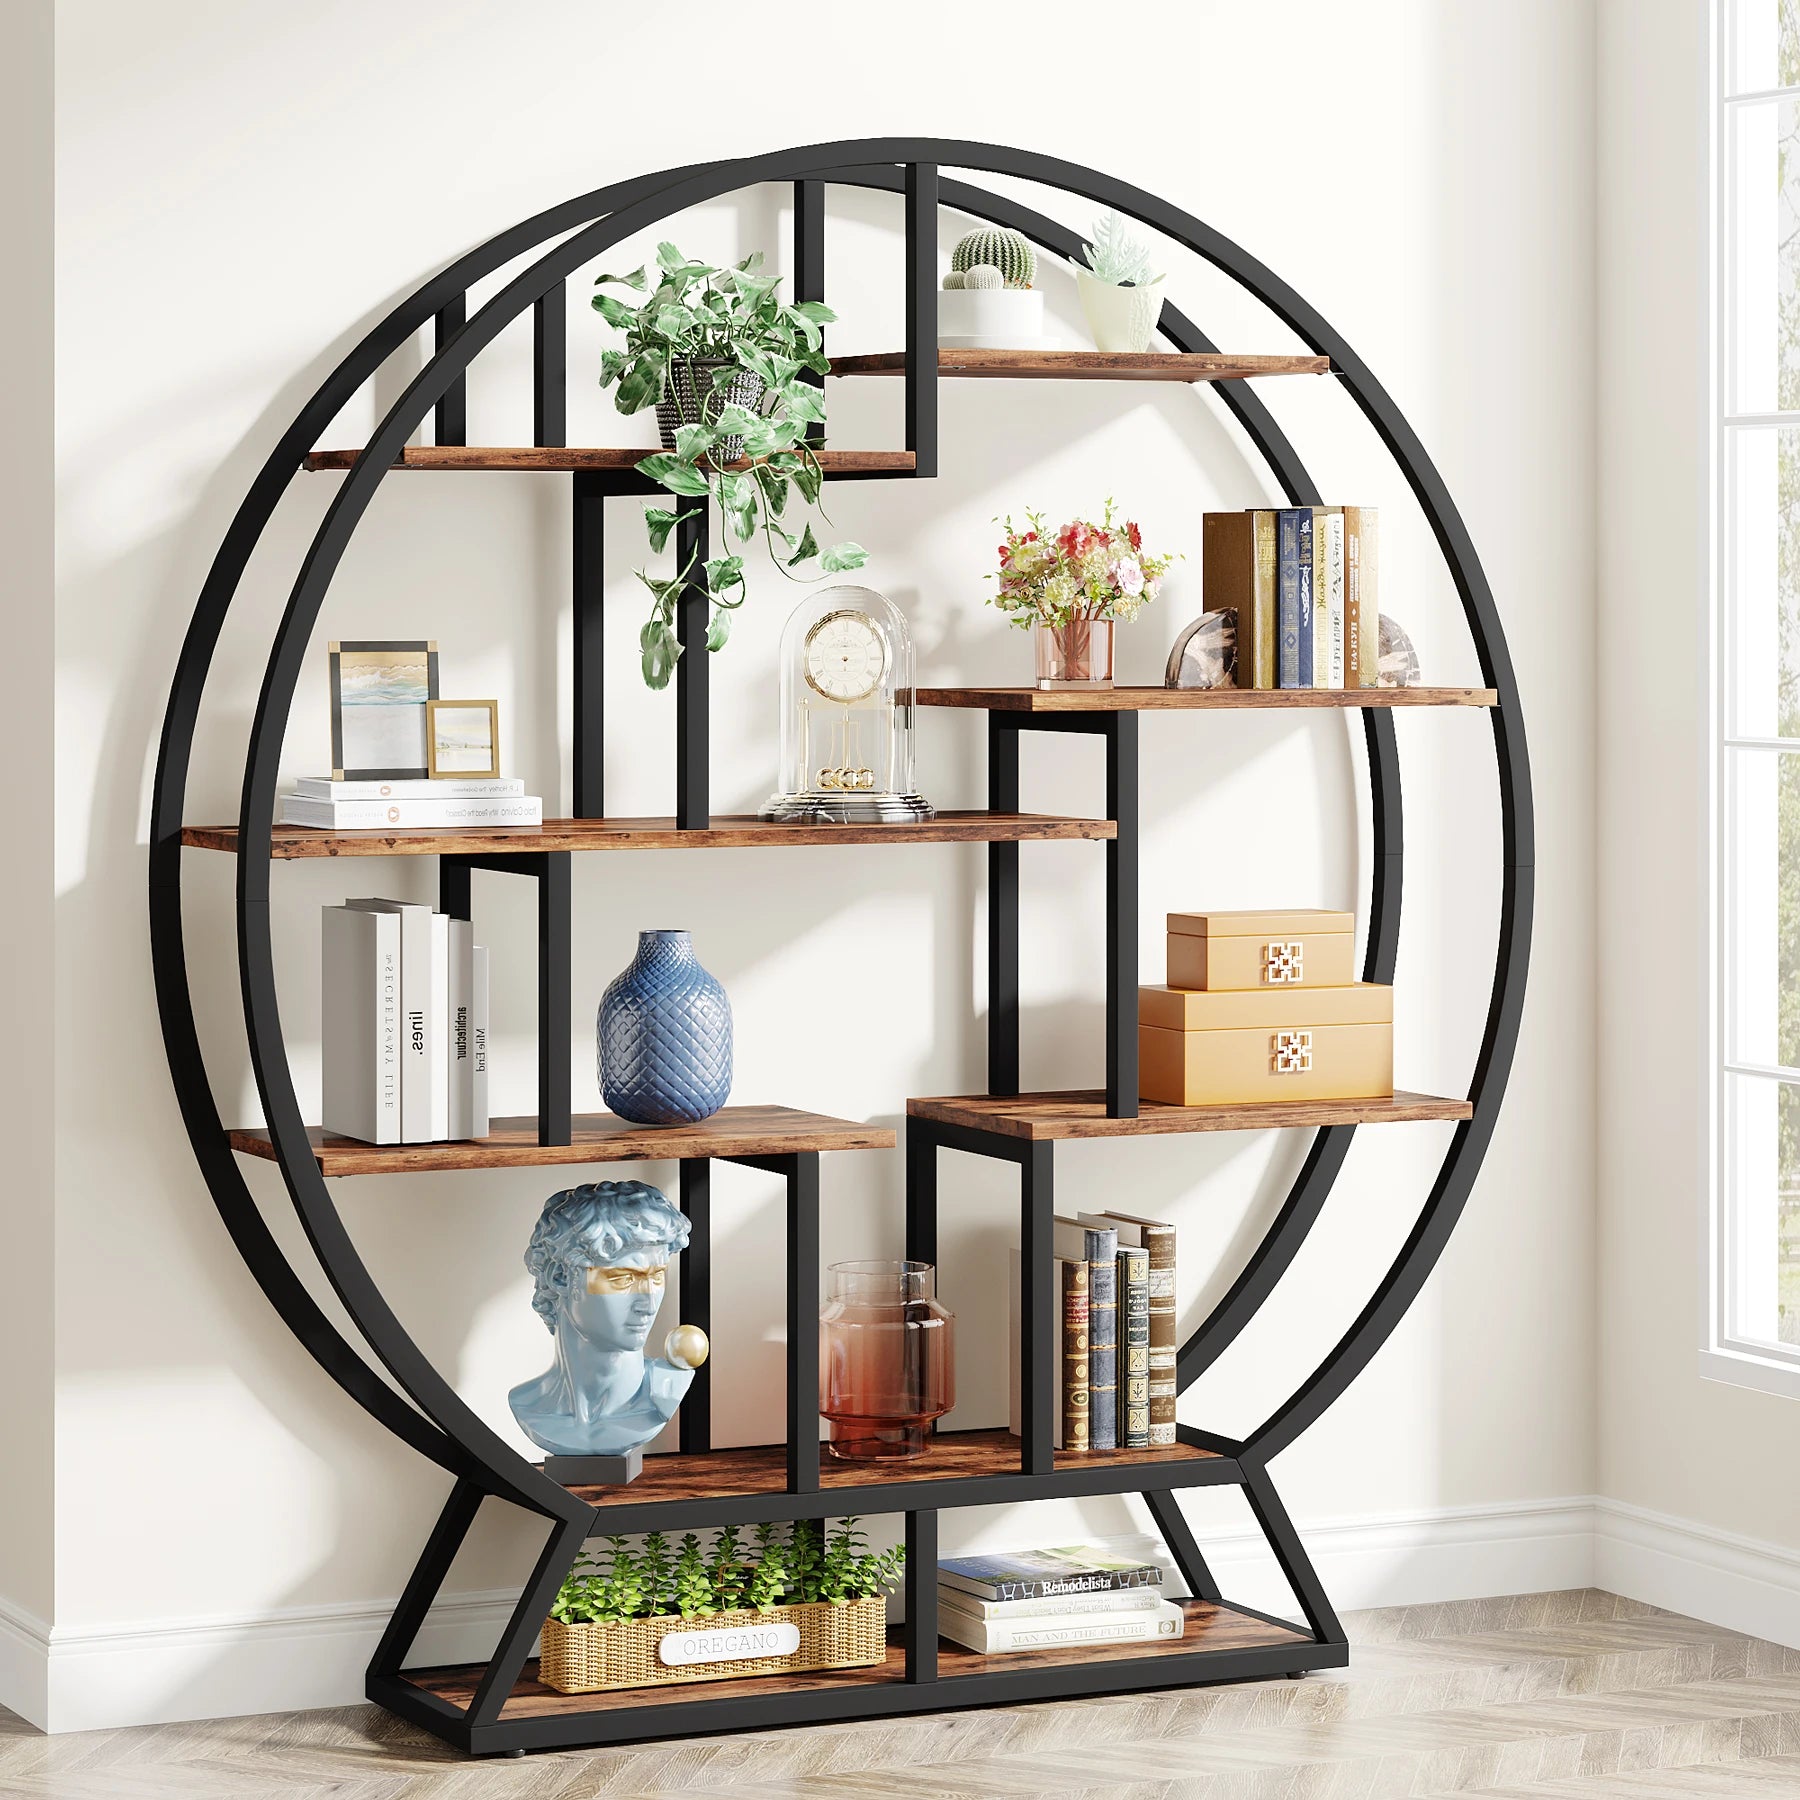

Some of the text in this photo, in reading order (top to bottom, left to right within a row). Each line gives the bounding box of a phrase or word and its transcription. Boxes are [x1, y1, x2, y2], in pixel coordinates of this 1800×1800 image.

[1316, 523, 1327, 609] Жажда жизни
[1043, 1577, 1111, 1594] Remodelista
[684, 1632, 779, 1655] OREGANO
[1011, 1633, 1041, 1644] MAN
[1042, 1631, 1069, 1642] AND
[1071, 1629, 1097, 1639] THE
[1100, 1625, 1146, 1637] FUTURE
